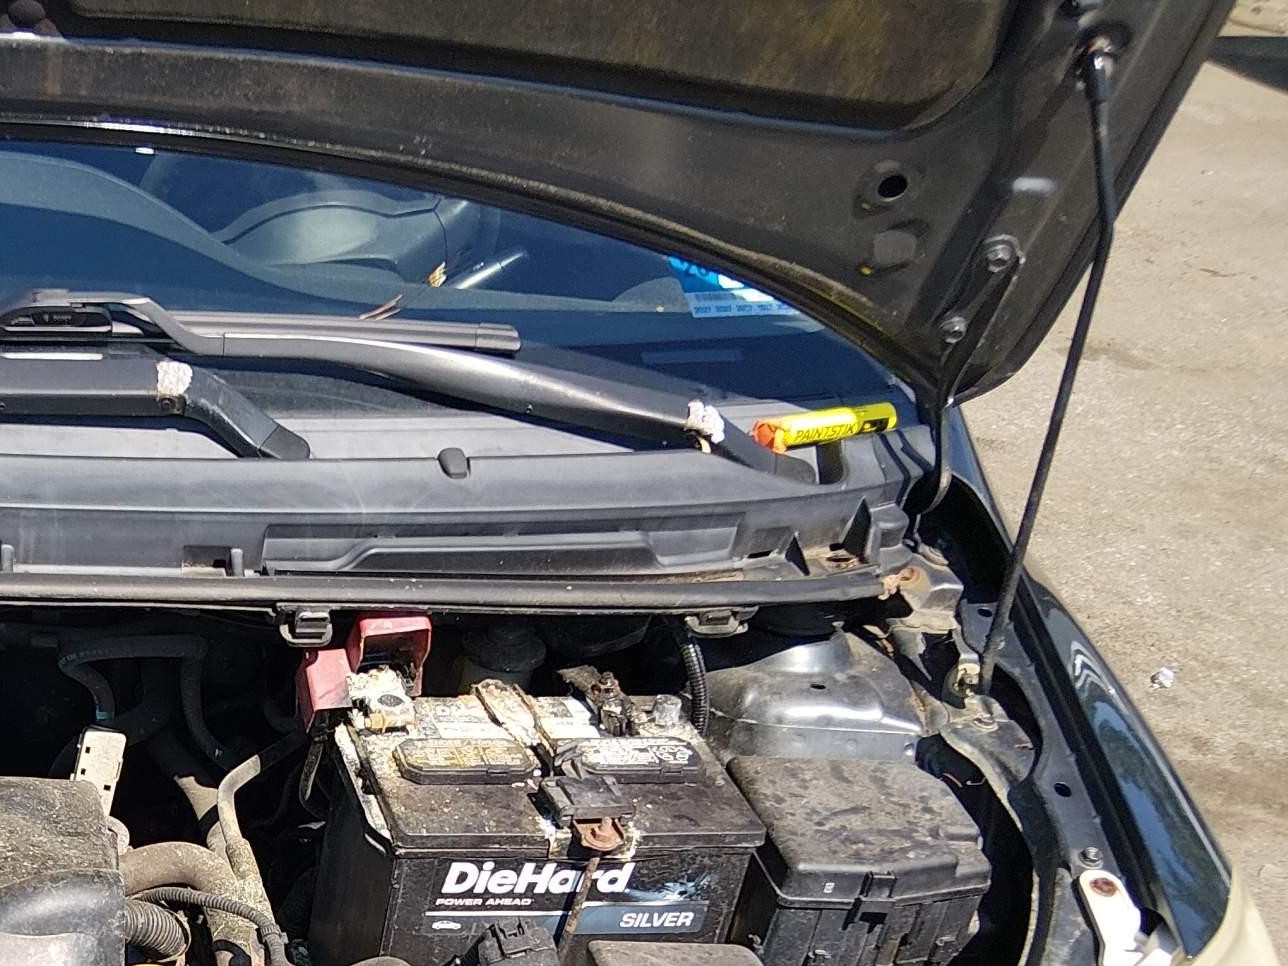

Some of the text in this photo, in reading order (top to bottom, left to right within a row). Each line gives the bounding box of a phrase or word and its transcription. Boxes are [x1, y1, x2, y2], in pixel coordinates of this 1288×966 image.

[795, 423, 854, 442] PAINTSTIK
[435, 898, 532, 906] POWER AHEAD
[620, 912, 695, 928] SILVER
